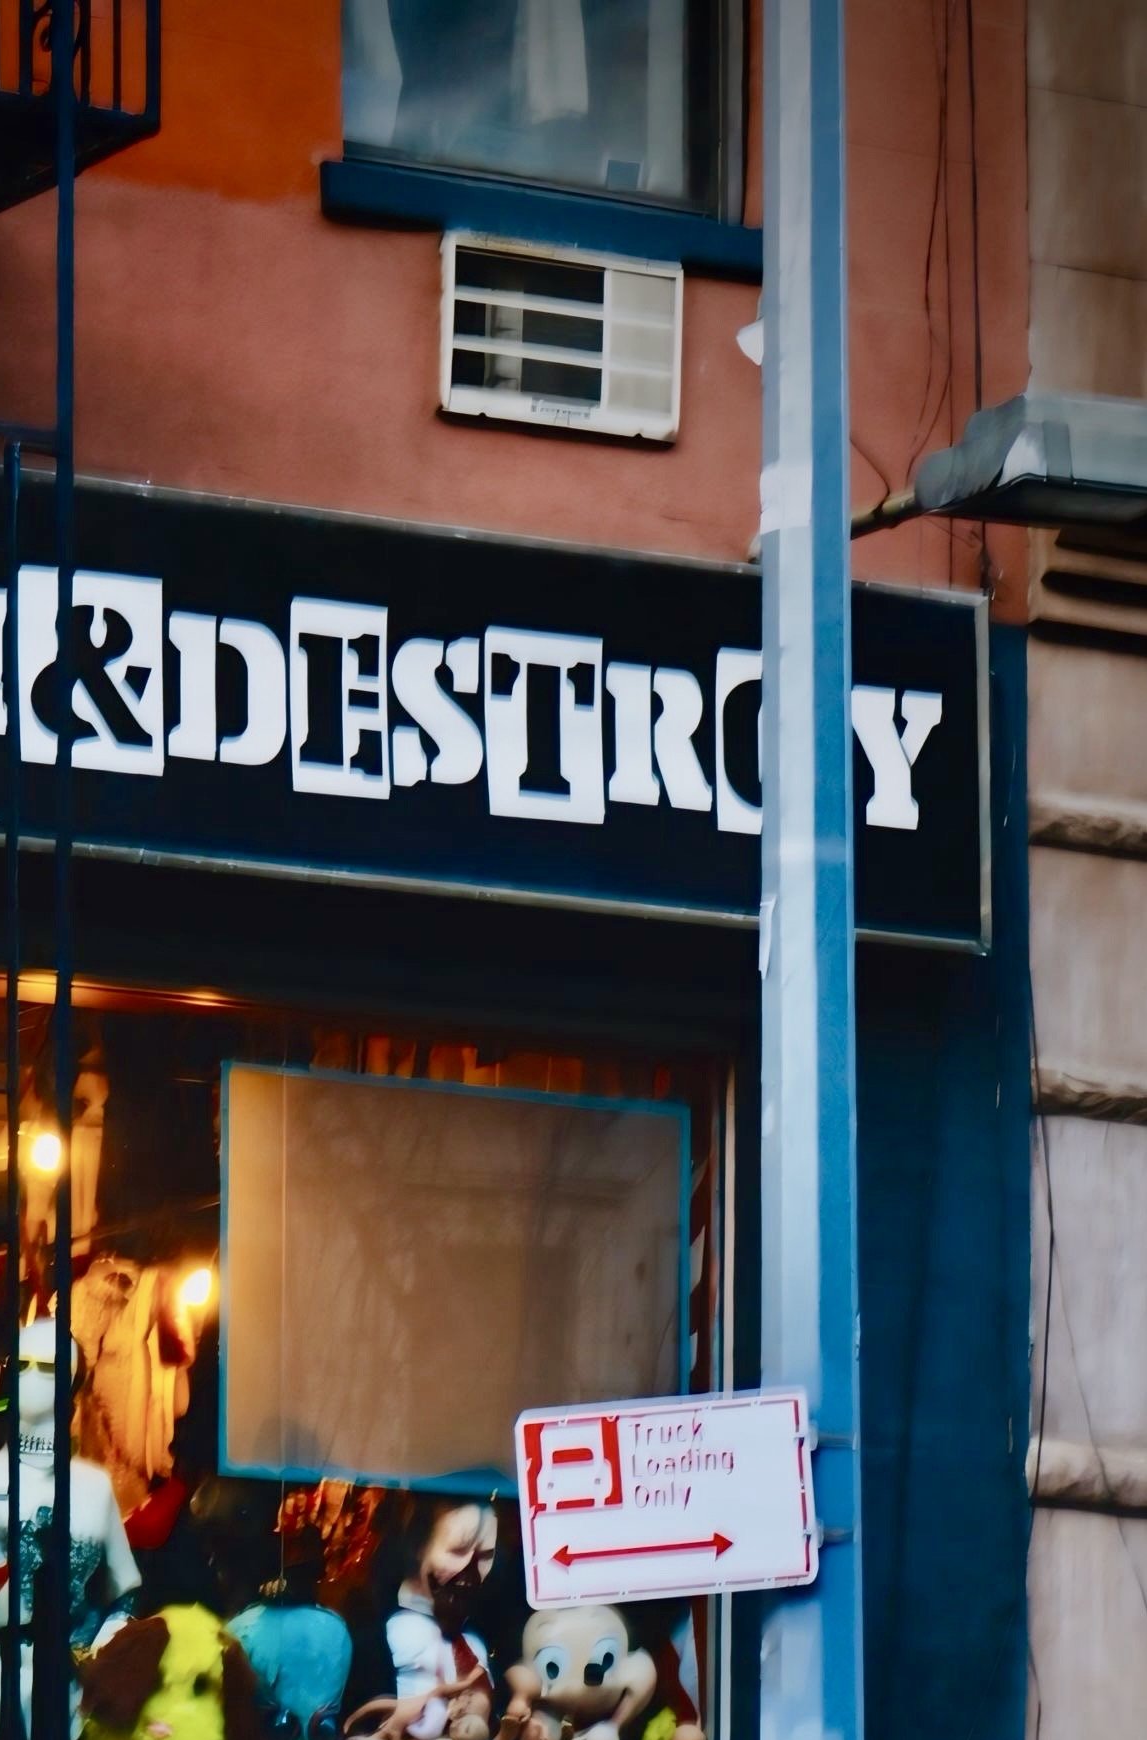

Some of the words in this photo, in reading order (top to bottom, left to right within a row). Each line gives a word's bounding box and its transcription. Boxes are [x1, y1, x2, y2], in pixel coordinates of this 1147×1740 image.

[628, 1409, 704, 1449] Truck
[631, 1448, 734, 1478] Loading
[634, 1481, 692, 1511] Only
